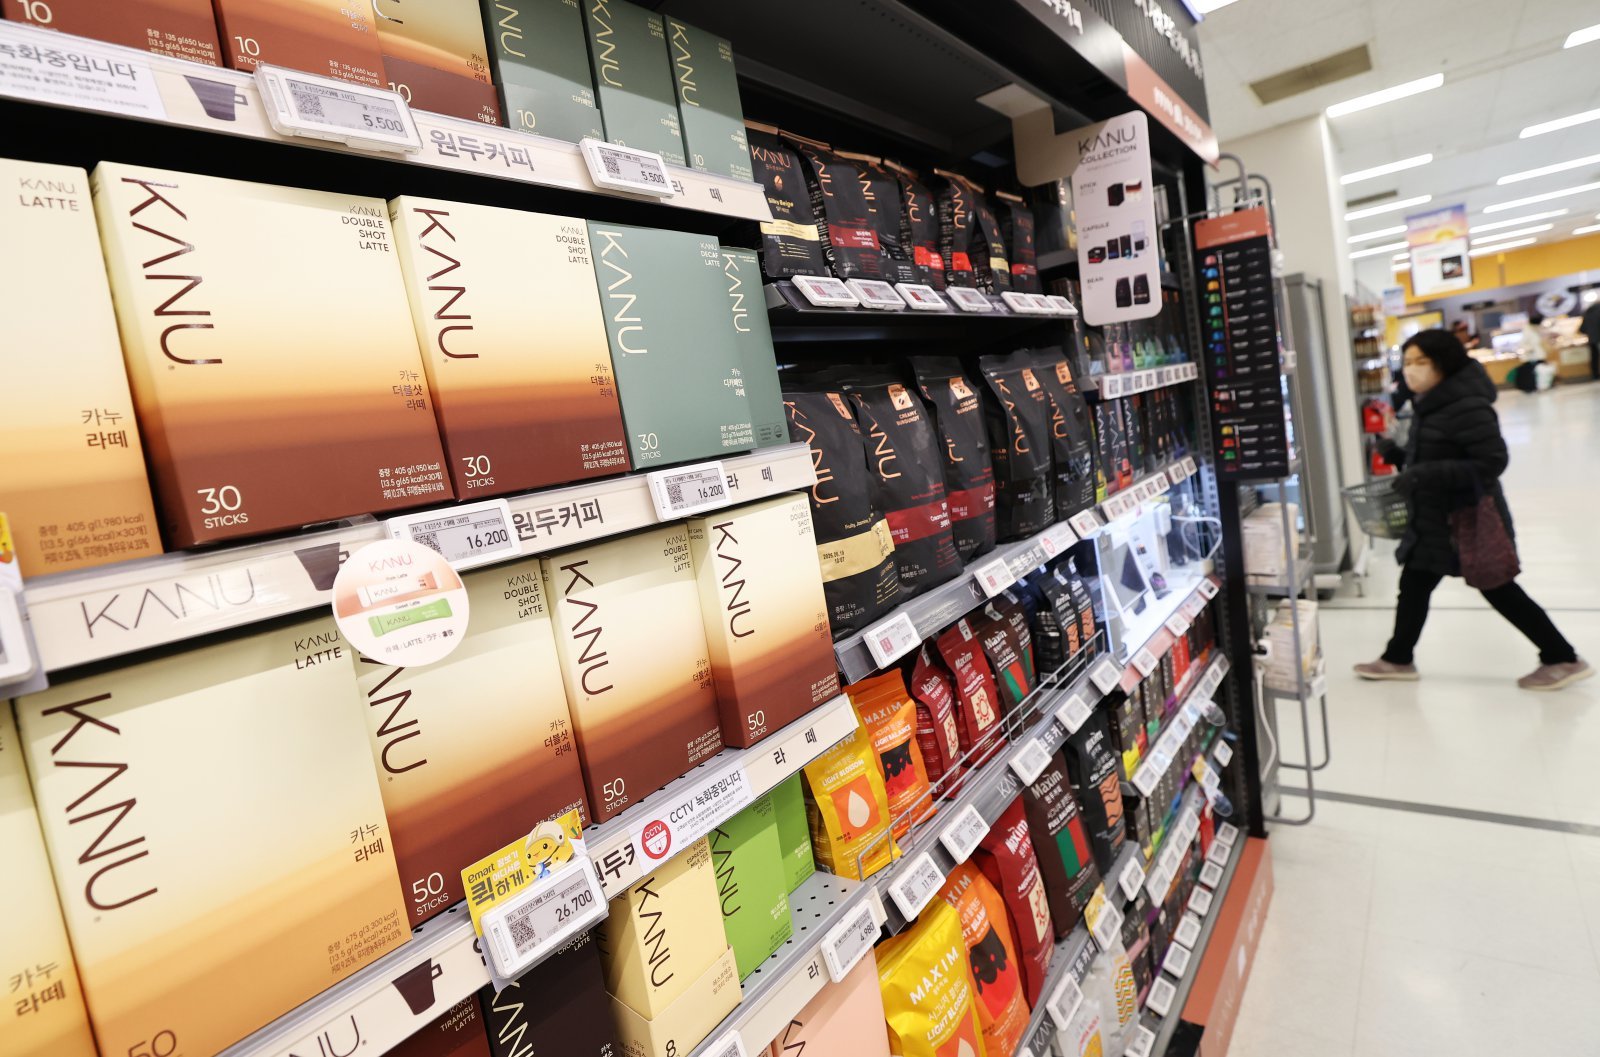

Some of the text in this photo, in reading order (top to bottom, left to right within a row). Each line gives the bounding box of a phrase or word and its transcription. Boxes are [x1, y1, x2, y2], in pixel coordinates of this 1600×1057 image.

[17, 0, 52, 24] 10
[235, 36, 260, 56] 10
[670, 22, 699, 107] KANU
[517, 109, 536, 128] 10
[1078, 125, 1136, 155] KANU
[430, 129, 535, 171] 원두커피
[750, 145, 791, 168] KANU
[1079, 144, 1137, 165] COLLECTION
[693, 154, 704, 166] 10
[19, 178, 77, 194] KANU
[670, 179, 723, 203] 라 떼
[19, 195, 80, 212] LATTE
[348, 204, 383, 219] KANU
[341, 215, 384, 229] DOUBLE
[560, 226, 583, 236] KANU
[359, 229, 386, 241] SHOT
[556, 235, 586, 246] DOUBLE
[359, 240, 389, 252] LATTE
[568, 246, 587, 255] SHOT
[700, 251, 719, 259] DECAF
[568, 256, 589, 265] LATTE
[704, 259, 720, 267] LATTE
[121, 177, 222, 364] KANU
[413, 208, 479, 358] KANU
[596, 230, 648, 354] KANU
[722, 253, 750, 332] KANU
[400, 369, 420, 382] 카누
[595, 363, 608, 373] 카누
[731, 367, 741, 377] 카누
[392, 383, 423, 397] 더블샷
[405, 397, 427, 411] 라떼
[81, 408, 123, 427] 카누
[86, 430, 129, 450] 라떼
[637, 433, 658, 451] 30
[641, 450, 661, 460] STICKS
[394, 467, 407, 475] 405
[462, 455, 491, 477] 30
[466, 477, 495, 489] STICKS
[726, 466, 773, 490] 라 떼
[197, 485, 242, 515] 30
[697, 484, 724, 499] 16,200
[204, 513, 249, 529] STICKS
[512, 497, 604, 542] 원두커피
[790, 510, 809, 521] DOUBLE
[797, 519, 810, 528] SHOT
[467, 529, 509, 550] 16,200
[665, 533, 687, 546] KANU
[797, 526, 812, 536] LATTE
[663, 543, 688, 556] DOUBLE
[673, 553, 688, 562] SHOT
[369, 553, 412, 573] KANU
[674, 561, 691, 572] LATTE
[507, 572, 538, 587] KANU
[713, 521, 755, 638] KANU
[503, 583, 539, 600] DOUBLE
[518, 594, 540, 607] SHOT
[81, 568, 256, 639] KANU
[518, 604, 543, 618] LATTE
[560, 559, 614, 696] KANU
[294, 630, 340, 652] KANU
[403, 637, 423, 649] LATTE
[984, 630, 1009, 650] Maxim
[295, 646, 342, 670] LATTE
[954, 652, 973, 670] Maxim
[921, 675, 942, 696] Maxim
[747, 710, 766, 731] 50
[864, 702, 903, 725] MAXIM
[550, 718, 565, 732] 카누
[749, 725, 768, 740] STICKS
[543, 730, 569, 748] 더블샷
[774, 728, 817, 765] 라 떼
[555, 744, 572, 758] 라떼
[823, 770, 839, 787] LIGHT
[839, 759, 865, 777] BLOSSOM
[603, 777, 626, 802] 50
[1031, 770, 1064, 801] Maxim
[41, 692, 158, 911] KANU
[605, 795, 629, 813] STICKS
[670, 770, 742, 824] CCTV 녹화중입니다
[350, 823, 380, 845] 카누
[644, 823, 664, 839] CCTV
[353, 838, 385, 863] 라떼
[687, 845, 707, 864] ESPRESSO
[467, 862, 495, 884] emart
[690, 859, 700, 869] MILK
[697, 857, 709, 870] LATTE
[411, 872, 444, 904] 50
[416, 893, 449, 917] STICKS
[555, 889, 593, 923] 26,700
[345, 932, 358, 944] 675
[635, 877, 674, 988] KANU
[558, 930, 590, 955] CHOCOLAT
[574, 936, 591, 952] LATTE
[10, 961, 59, 994] 카누
[807, 960, 820, 980] 라
[909, 945, 959, 1005] MAXIM
[15, 980, 66, 1017] 라떼
[440, 1004, 474, 1032] TIRAMISU
[926, 984, 968, 1041] LIGHT BLOSSOM
[455, 1016, 476, 1032] LATTE
[128, 1030, 177, 1057] 50
[665, 1039, 677, 1057] 8
